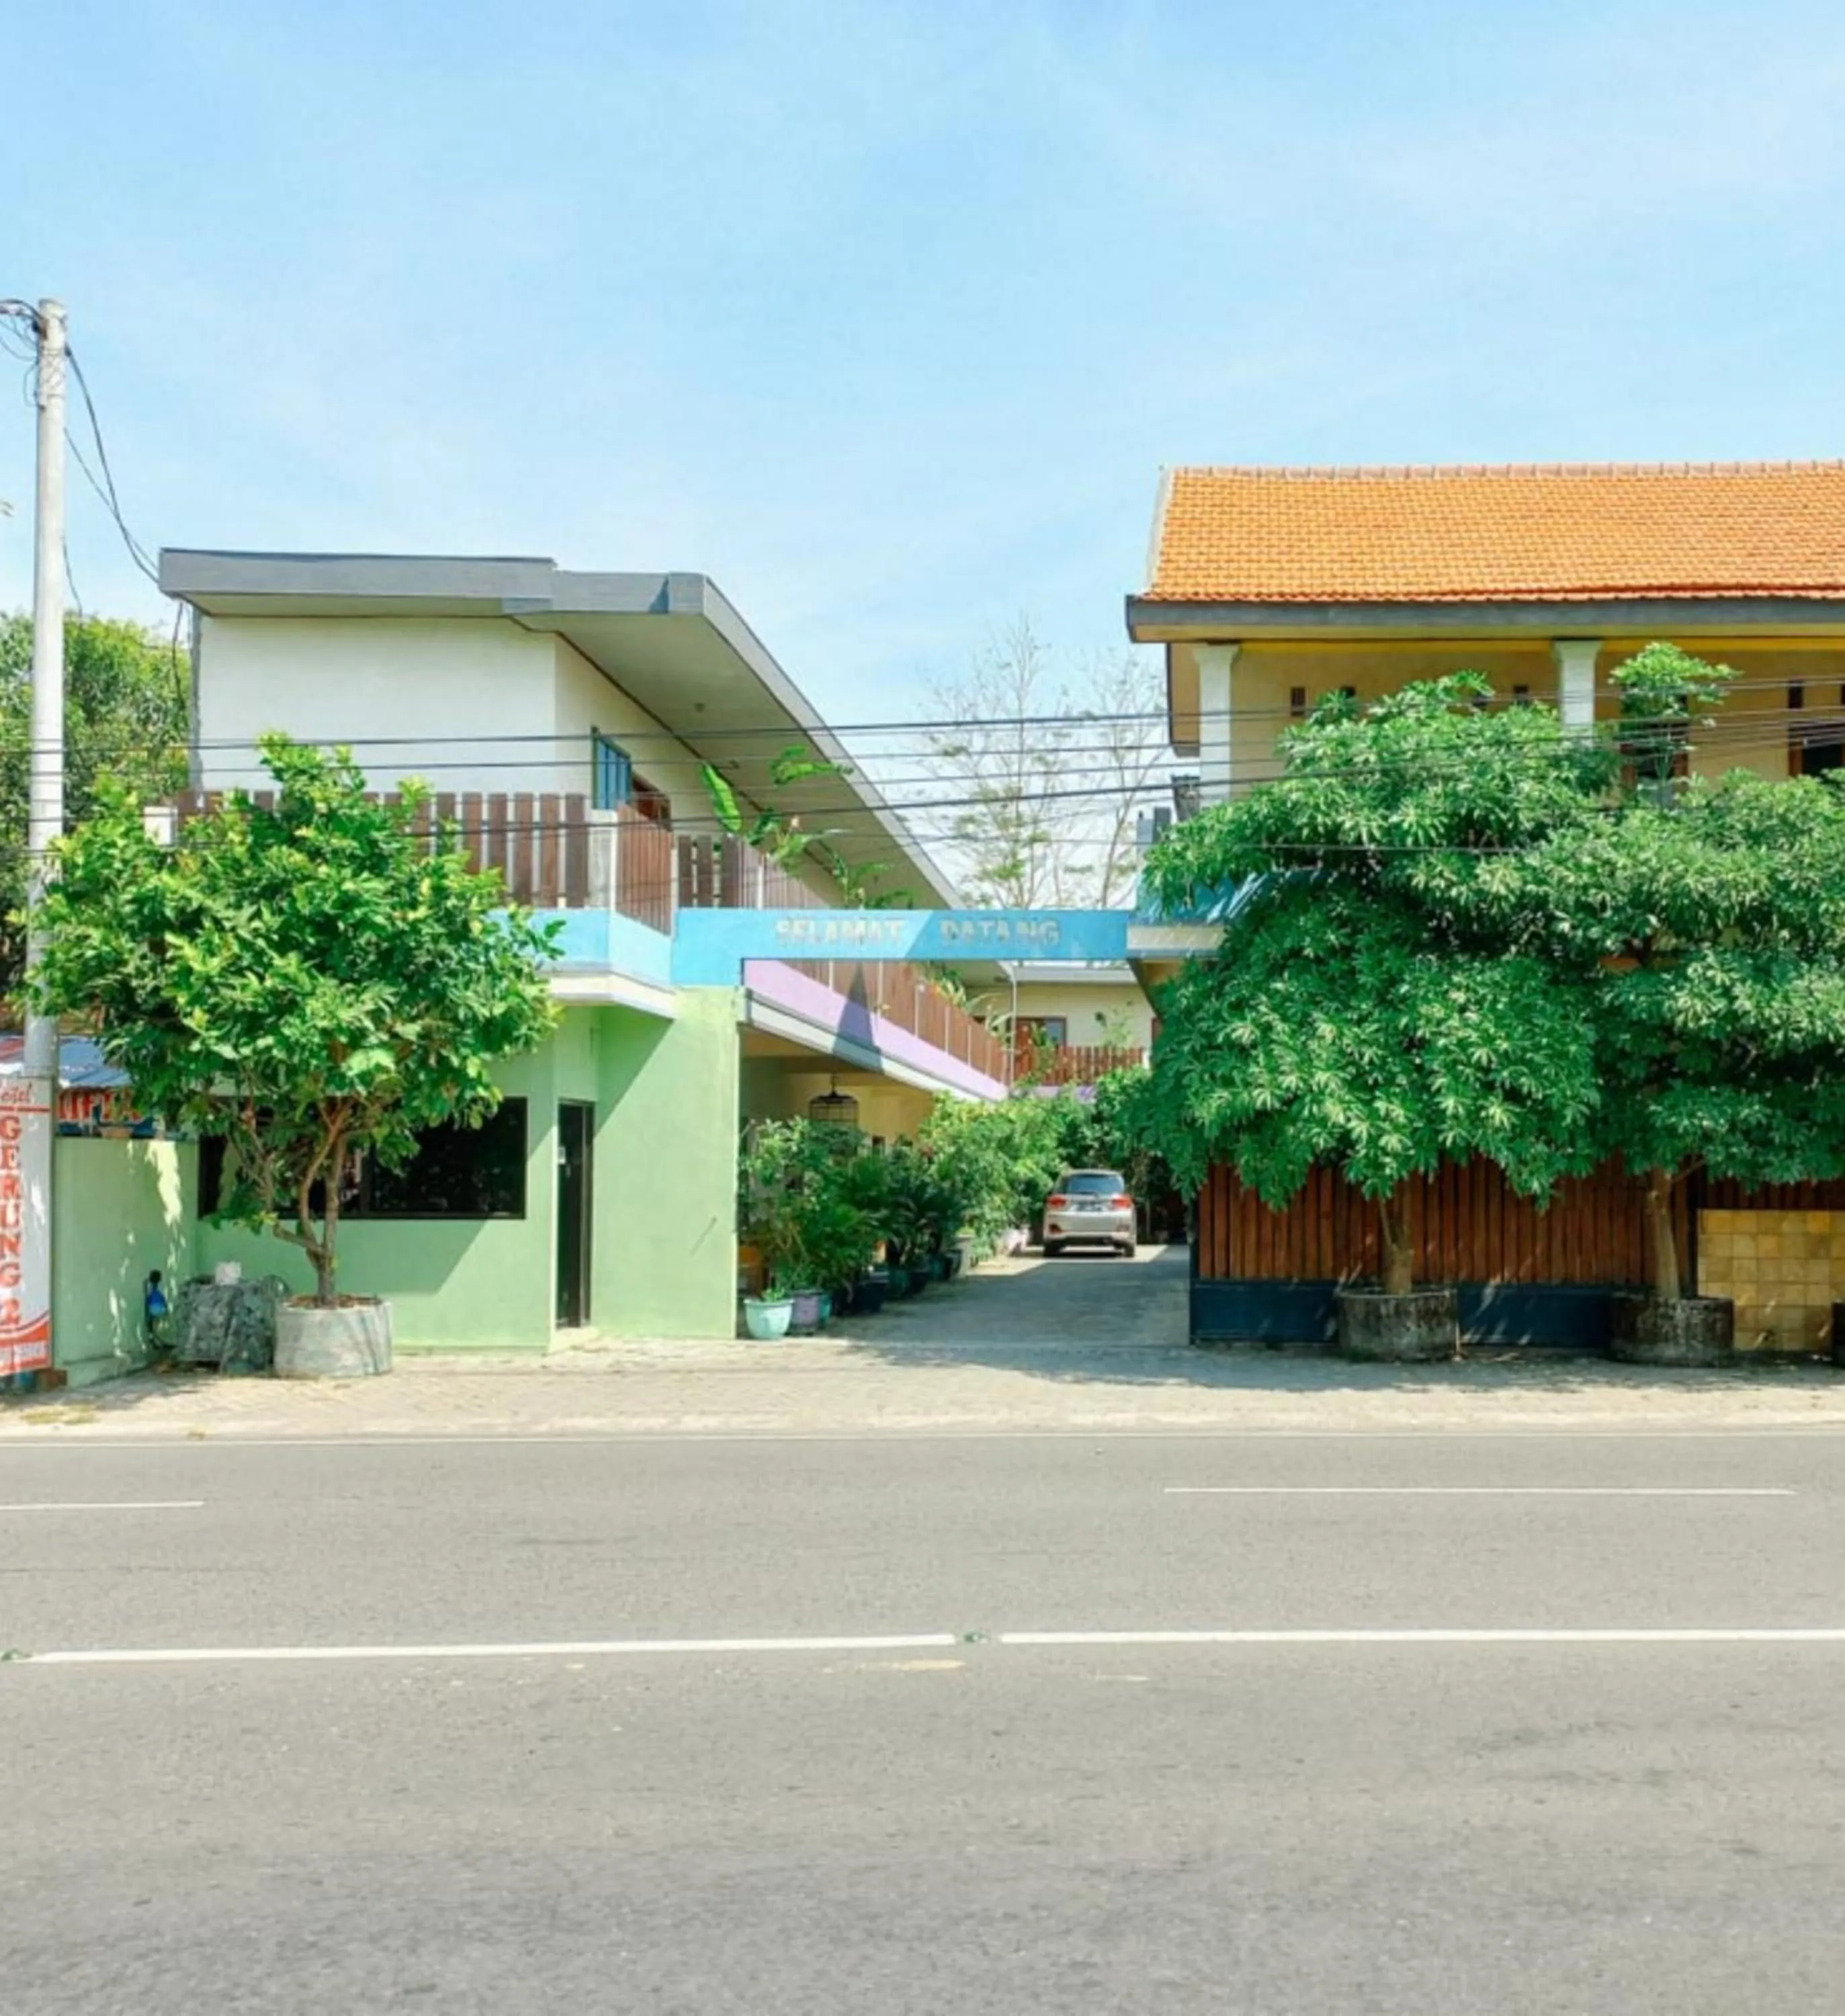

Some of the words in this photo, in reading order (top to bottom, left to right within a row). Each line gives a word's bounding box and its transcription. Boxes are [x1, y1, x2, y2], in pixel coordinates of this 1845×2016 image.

[775, 918, 910, 943] SELAMAT
[939, 918, 1061, 945] DATANG
[0, 1080, 32, 1104] otel
